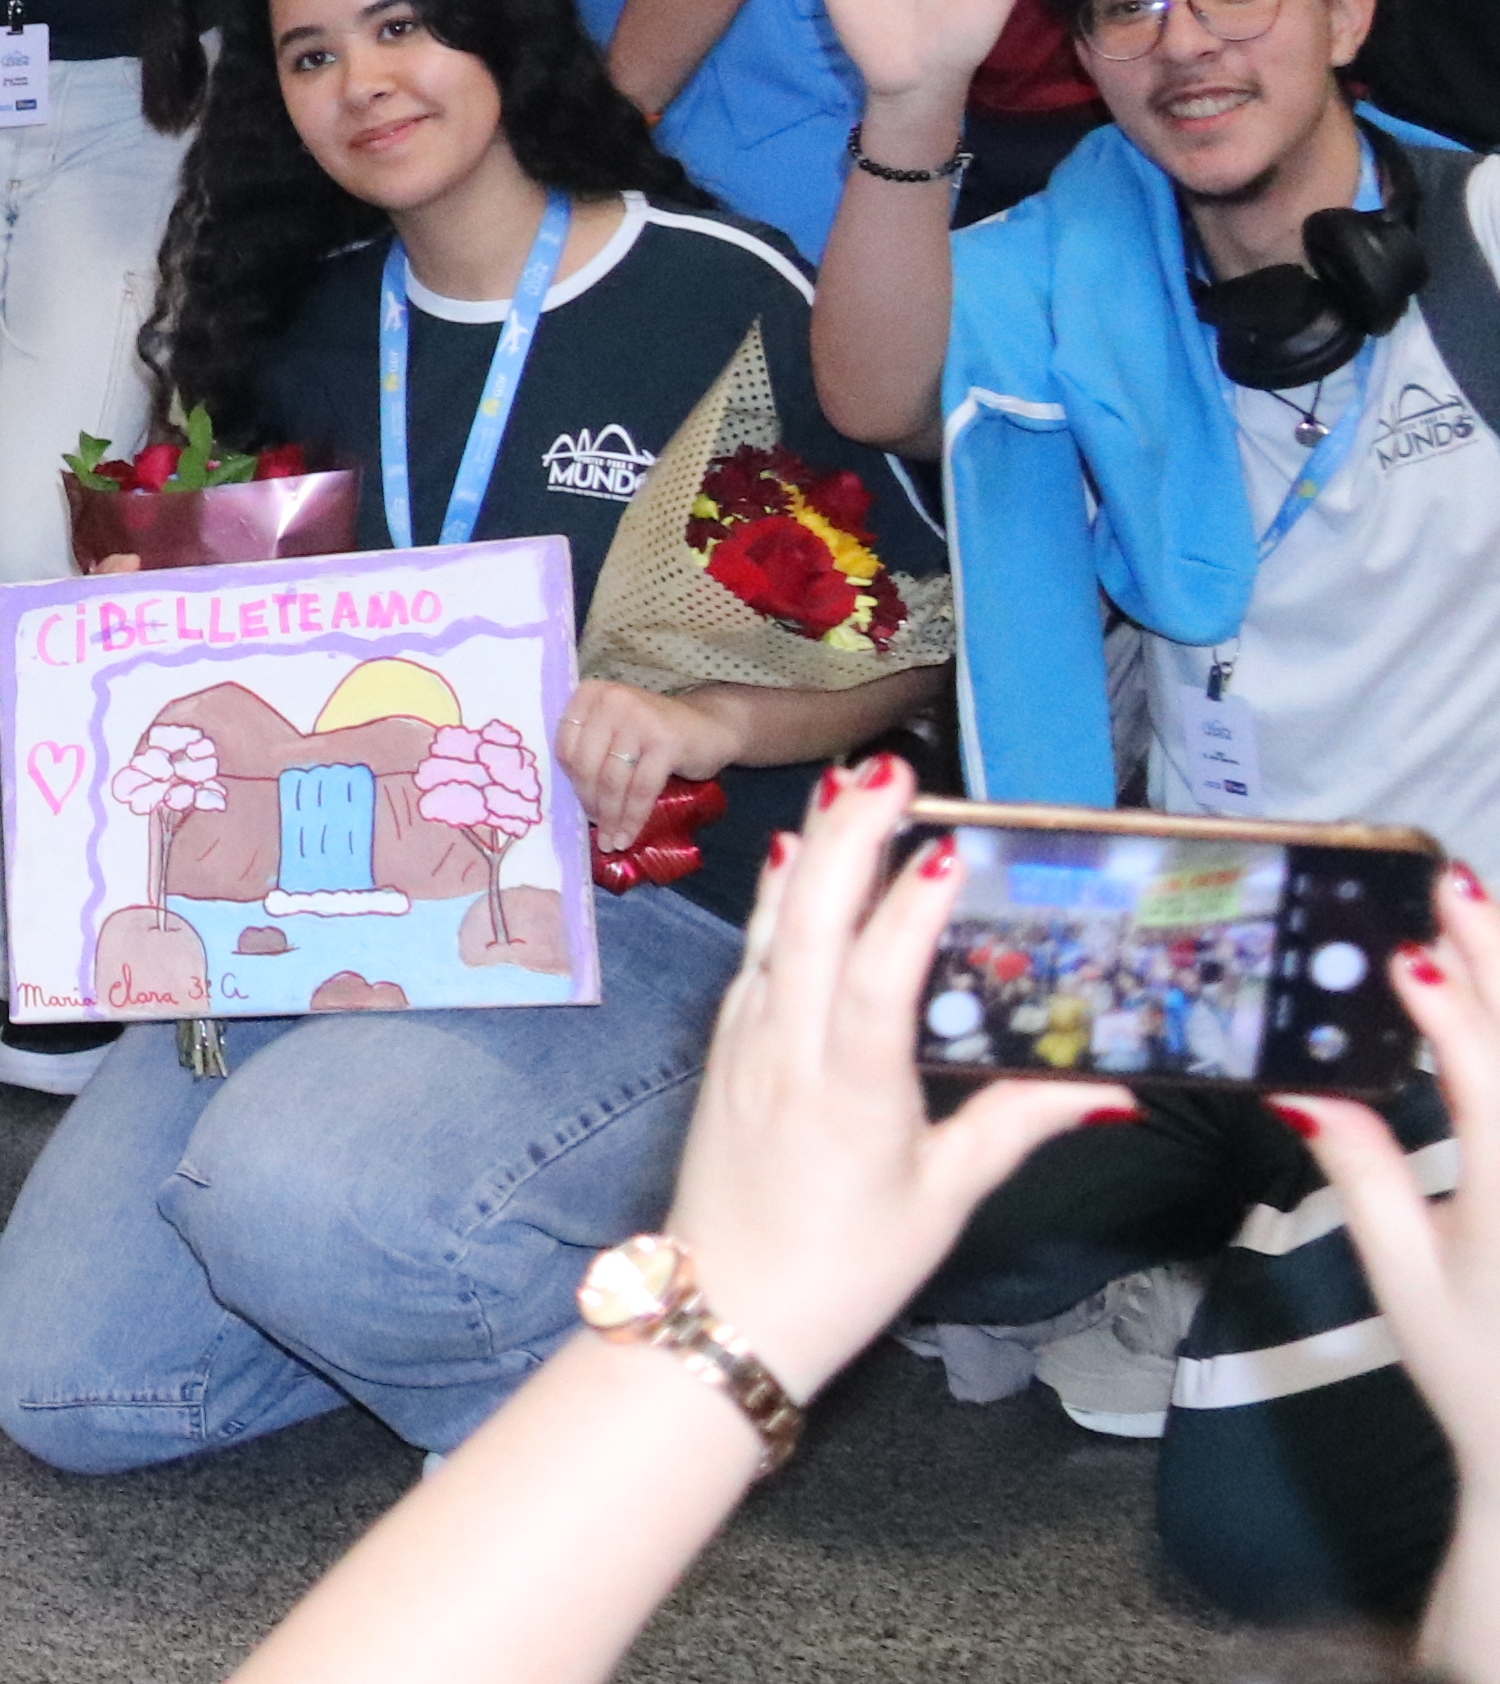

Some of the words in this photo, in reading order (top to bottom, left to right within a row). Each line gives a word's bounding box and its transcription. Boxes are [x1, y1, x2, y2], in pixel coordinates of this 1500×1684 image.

[1377, 414, 1474, 471] MUNDO
[17, 981, 96, 1008] Maria
[109, 963, 180, 1008] Clara
